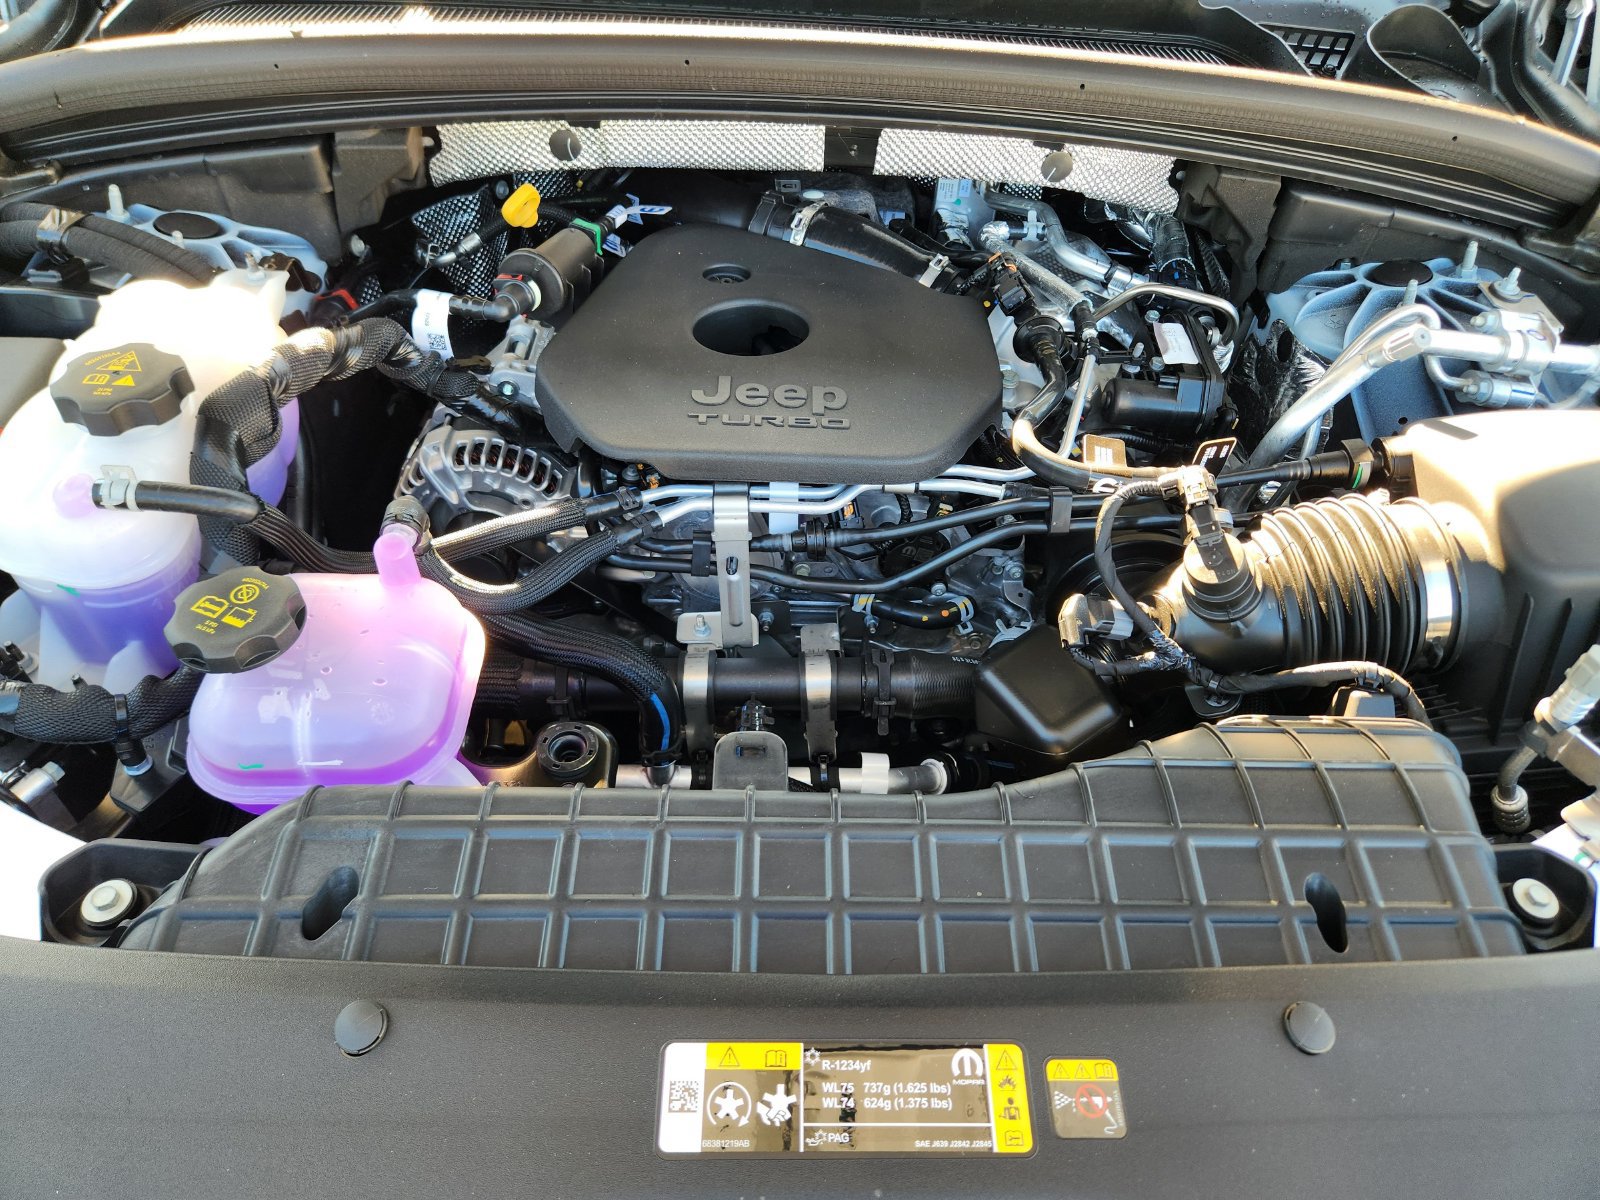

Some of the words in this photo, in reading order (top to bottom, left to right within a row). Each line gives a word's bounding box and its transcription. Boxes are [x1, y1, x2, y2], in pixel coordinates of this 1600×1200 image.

[691, 375, 848, 416] Jeep
[687, 413, 851, 430] TURBO
[822, 1059, 872, 1073] R-1234yf
[822, 1081, 855, 1093] WL75
[863, 1081, 891, 1095] 737g
[893, 1081, 928, 1095] (1.625
[930, 1082, 952, 1094] lbs)
[952, 1078, 985, 1086] MOPAR
[822, 1097, 855, 1109] WL74
[863, 1097, 892, 1111] 624g
[894, 1097, 929, 1111] (1.375
[931, 1098, 953, 1111] lbs)
[702, 1139, 750, 1148] 68381219AB
[828, 1132, 850, 1143] PAG
[914, 1140, 931, 1148] SAE
[932, 1140, 949, 1148] J639
[950, 1140, 970, 1148] J2842
